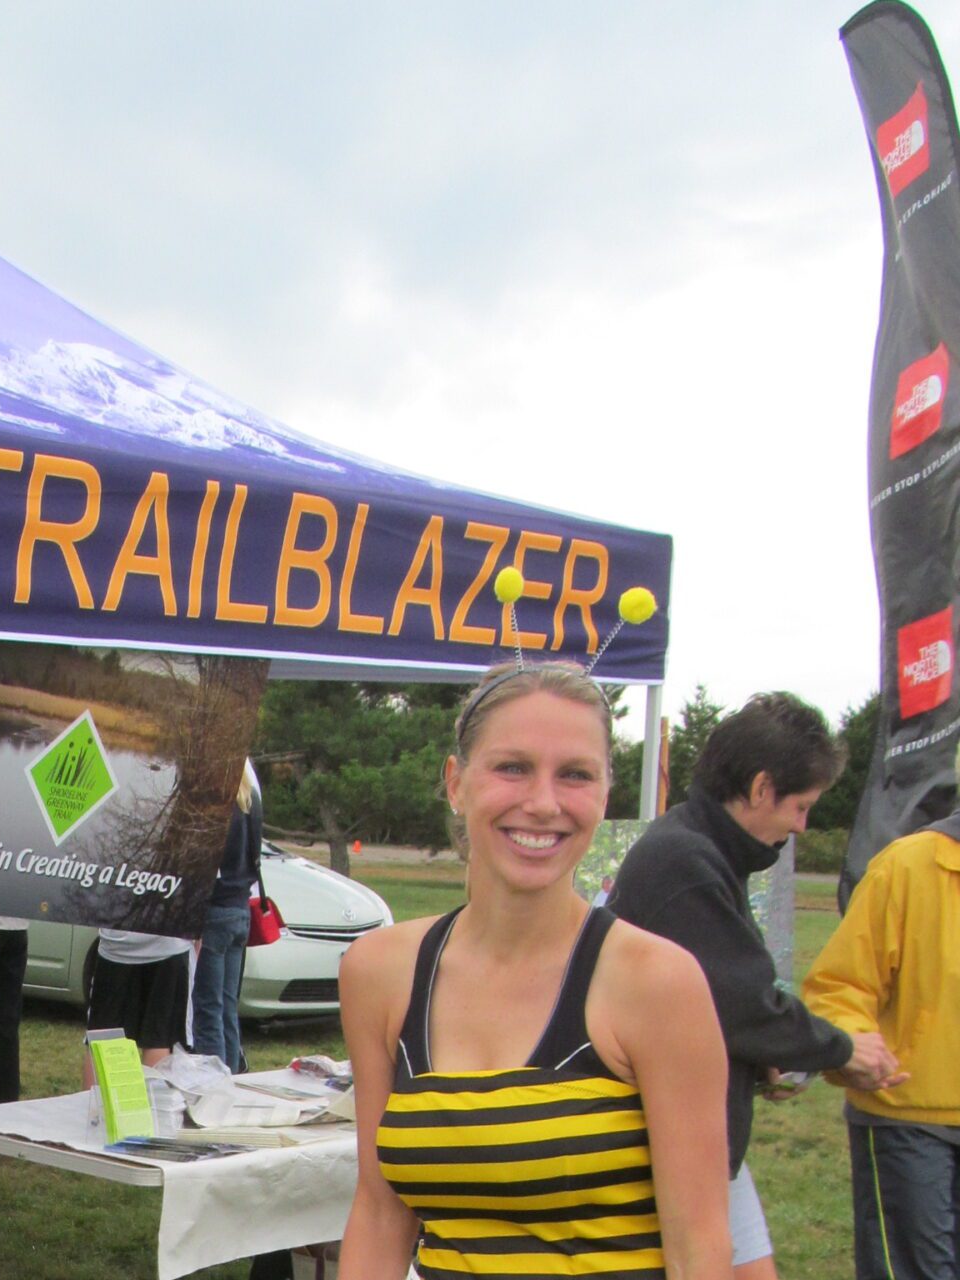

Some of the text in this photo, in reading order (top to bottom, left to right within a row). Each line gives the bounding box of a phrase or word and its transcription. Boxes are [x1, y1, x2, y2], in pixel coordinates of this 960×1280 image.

[894, 472, 921, 492] STOP
[904, 737, 930, 753] STOP
[15, 849, 99, 887] Creating
[98, 866, 112, 884] a
[115, 863, 183, 898] Legacy
